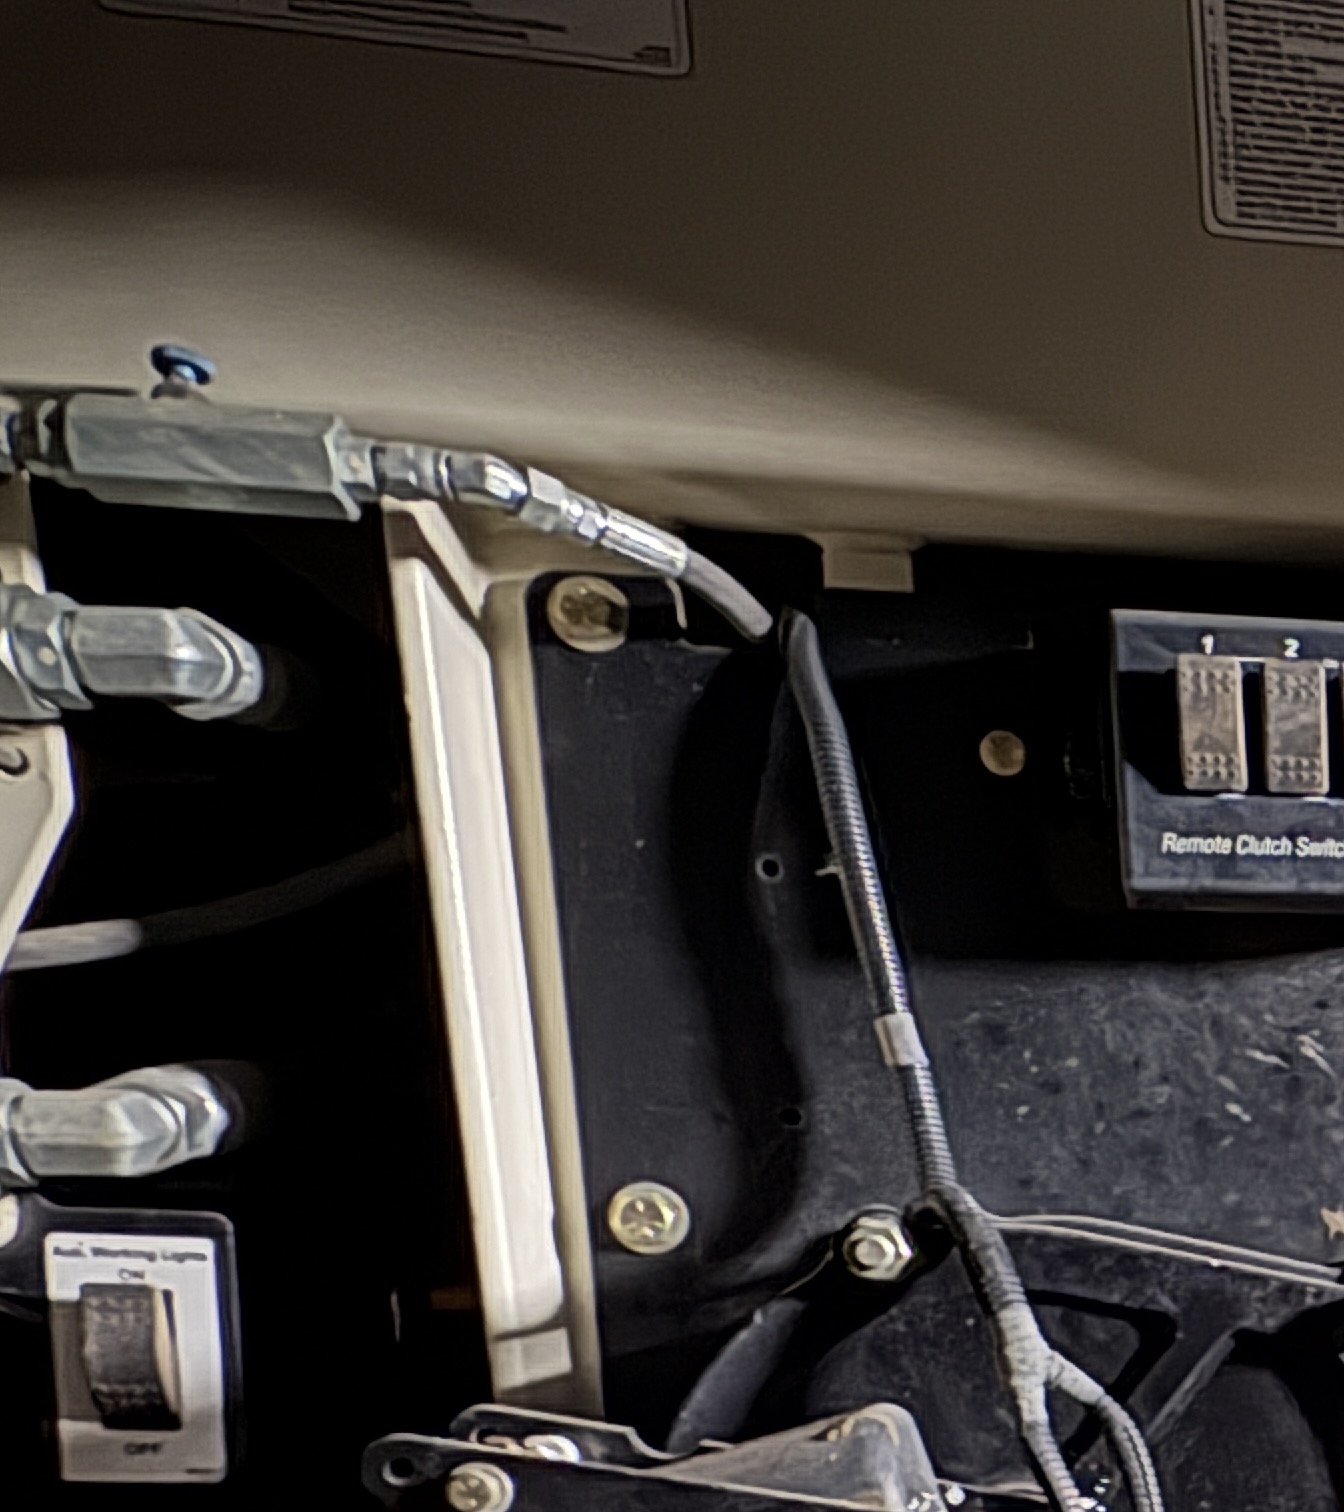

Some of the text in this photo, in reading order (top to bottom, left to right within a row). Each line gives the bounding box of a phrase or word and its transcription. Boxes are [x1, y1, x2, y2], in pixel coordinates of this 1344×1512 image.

[1200, 634, 1215, 656] 1
[1284, 637, 1301, 659] 2
[1162, 832, 1233, 855] Remote
[1236, 834, 1293, 857] Clutch
